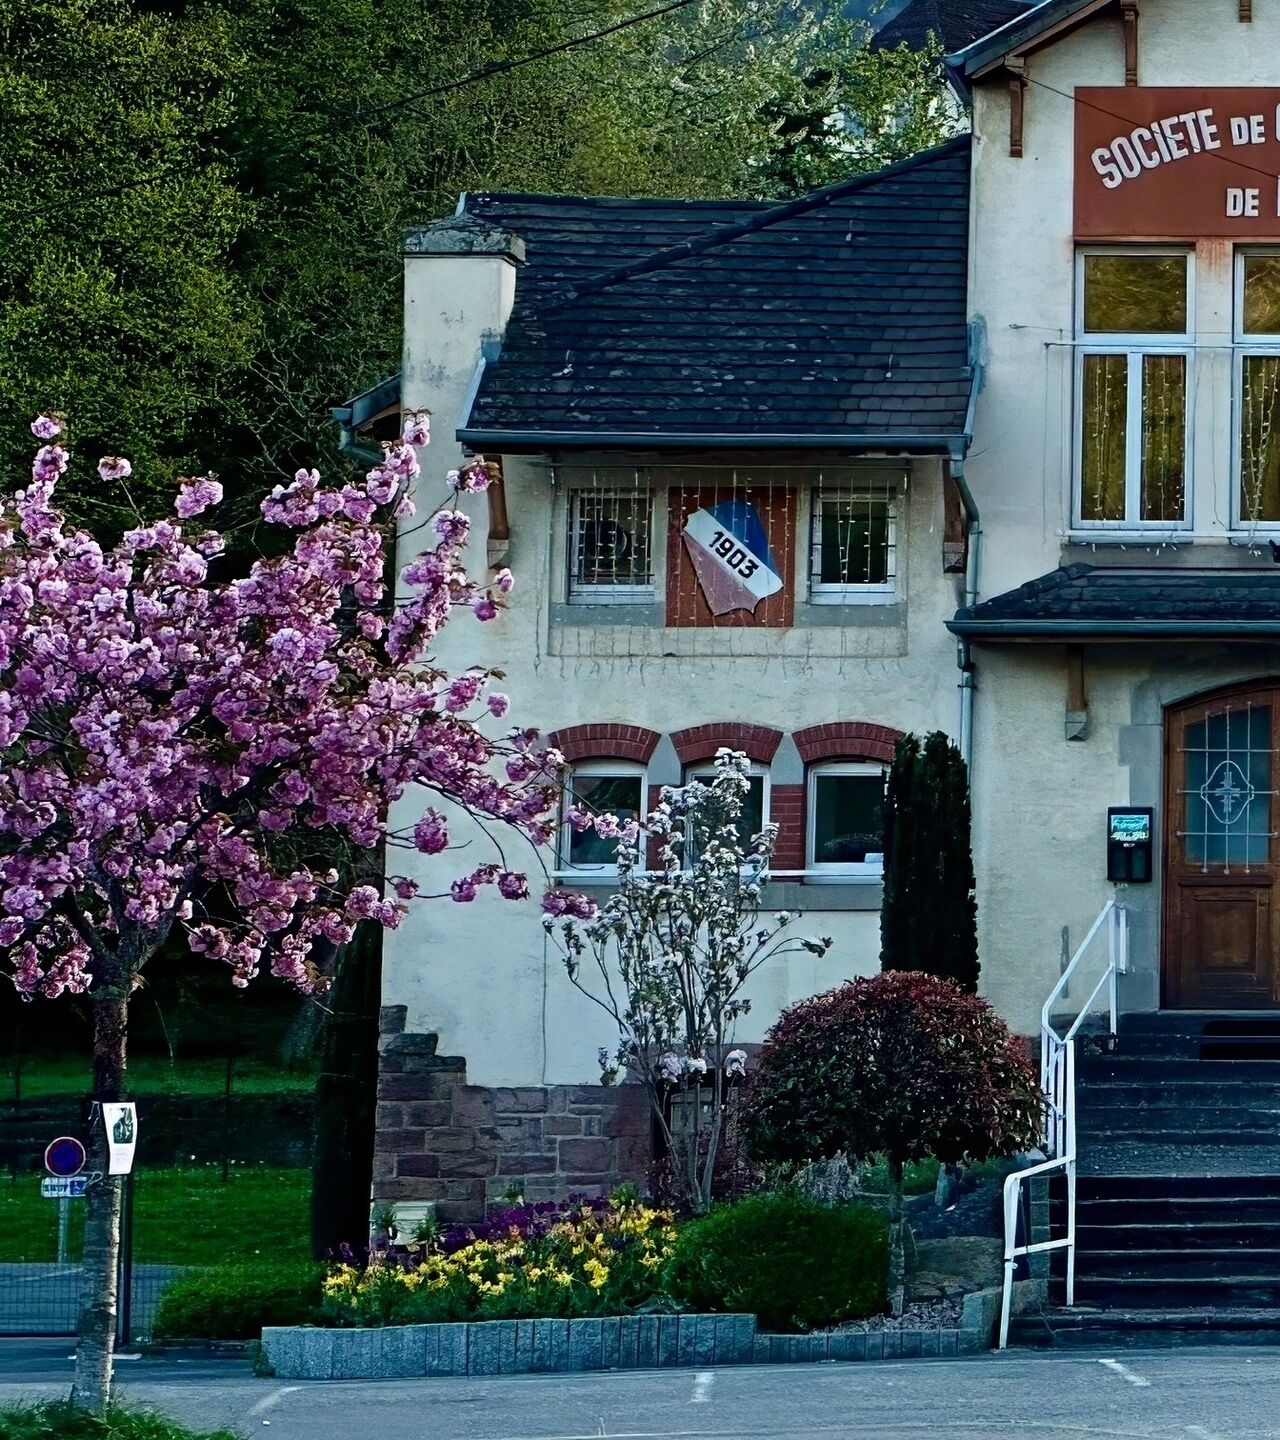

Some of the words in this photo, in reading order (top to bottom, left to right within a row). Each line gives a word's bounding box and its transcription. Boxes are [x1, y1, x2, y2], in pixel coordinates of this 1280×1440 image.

[1091, 108, 1221, 189] SOCIETE
[1230, 115, 1265, 145] DE
[1226, 188, 1260, 216] DE
[708, 531, 759, 579] 1903
